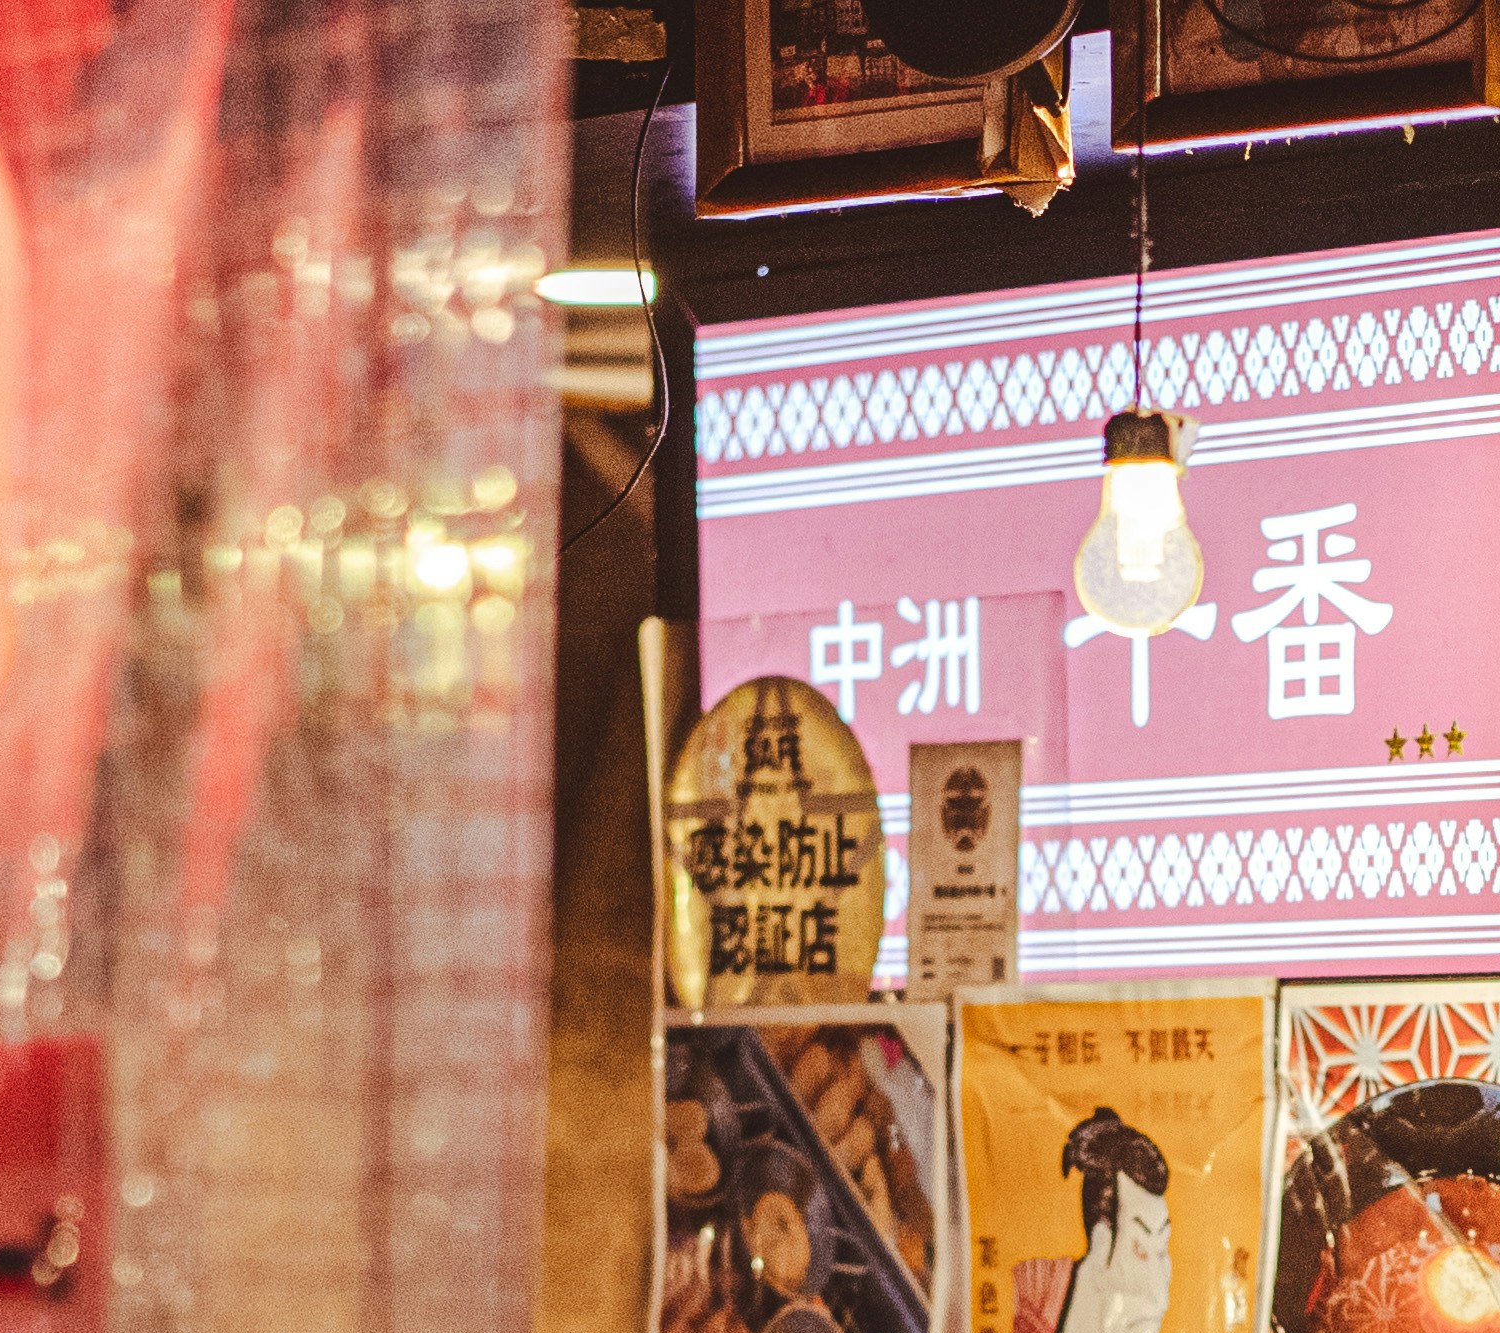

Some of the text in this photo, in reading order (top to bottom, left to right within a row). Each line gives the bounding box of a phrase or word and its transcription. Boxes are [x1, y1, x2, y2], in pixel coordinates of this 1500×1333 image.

[809, 596, 980, 724] 中洲
[690, 814, 858, 892] 感染防止
[711, 902, 837, 974] 認証店
